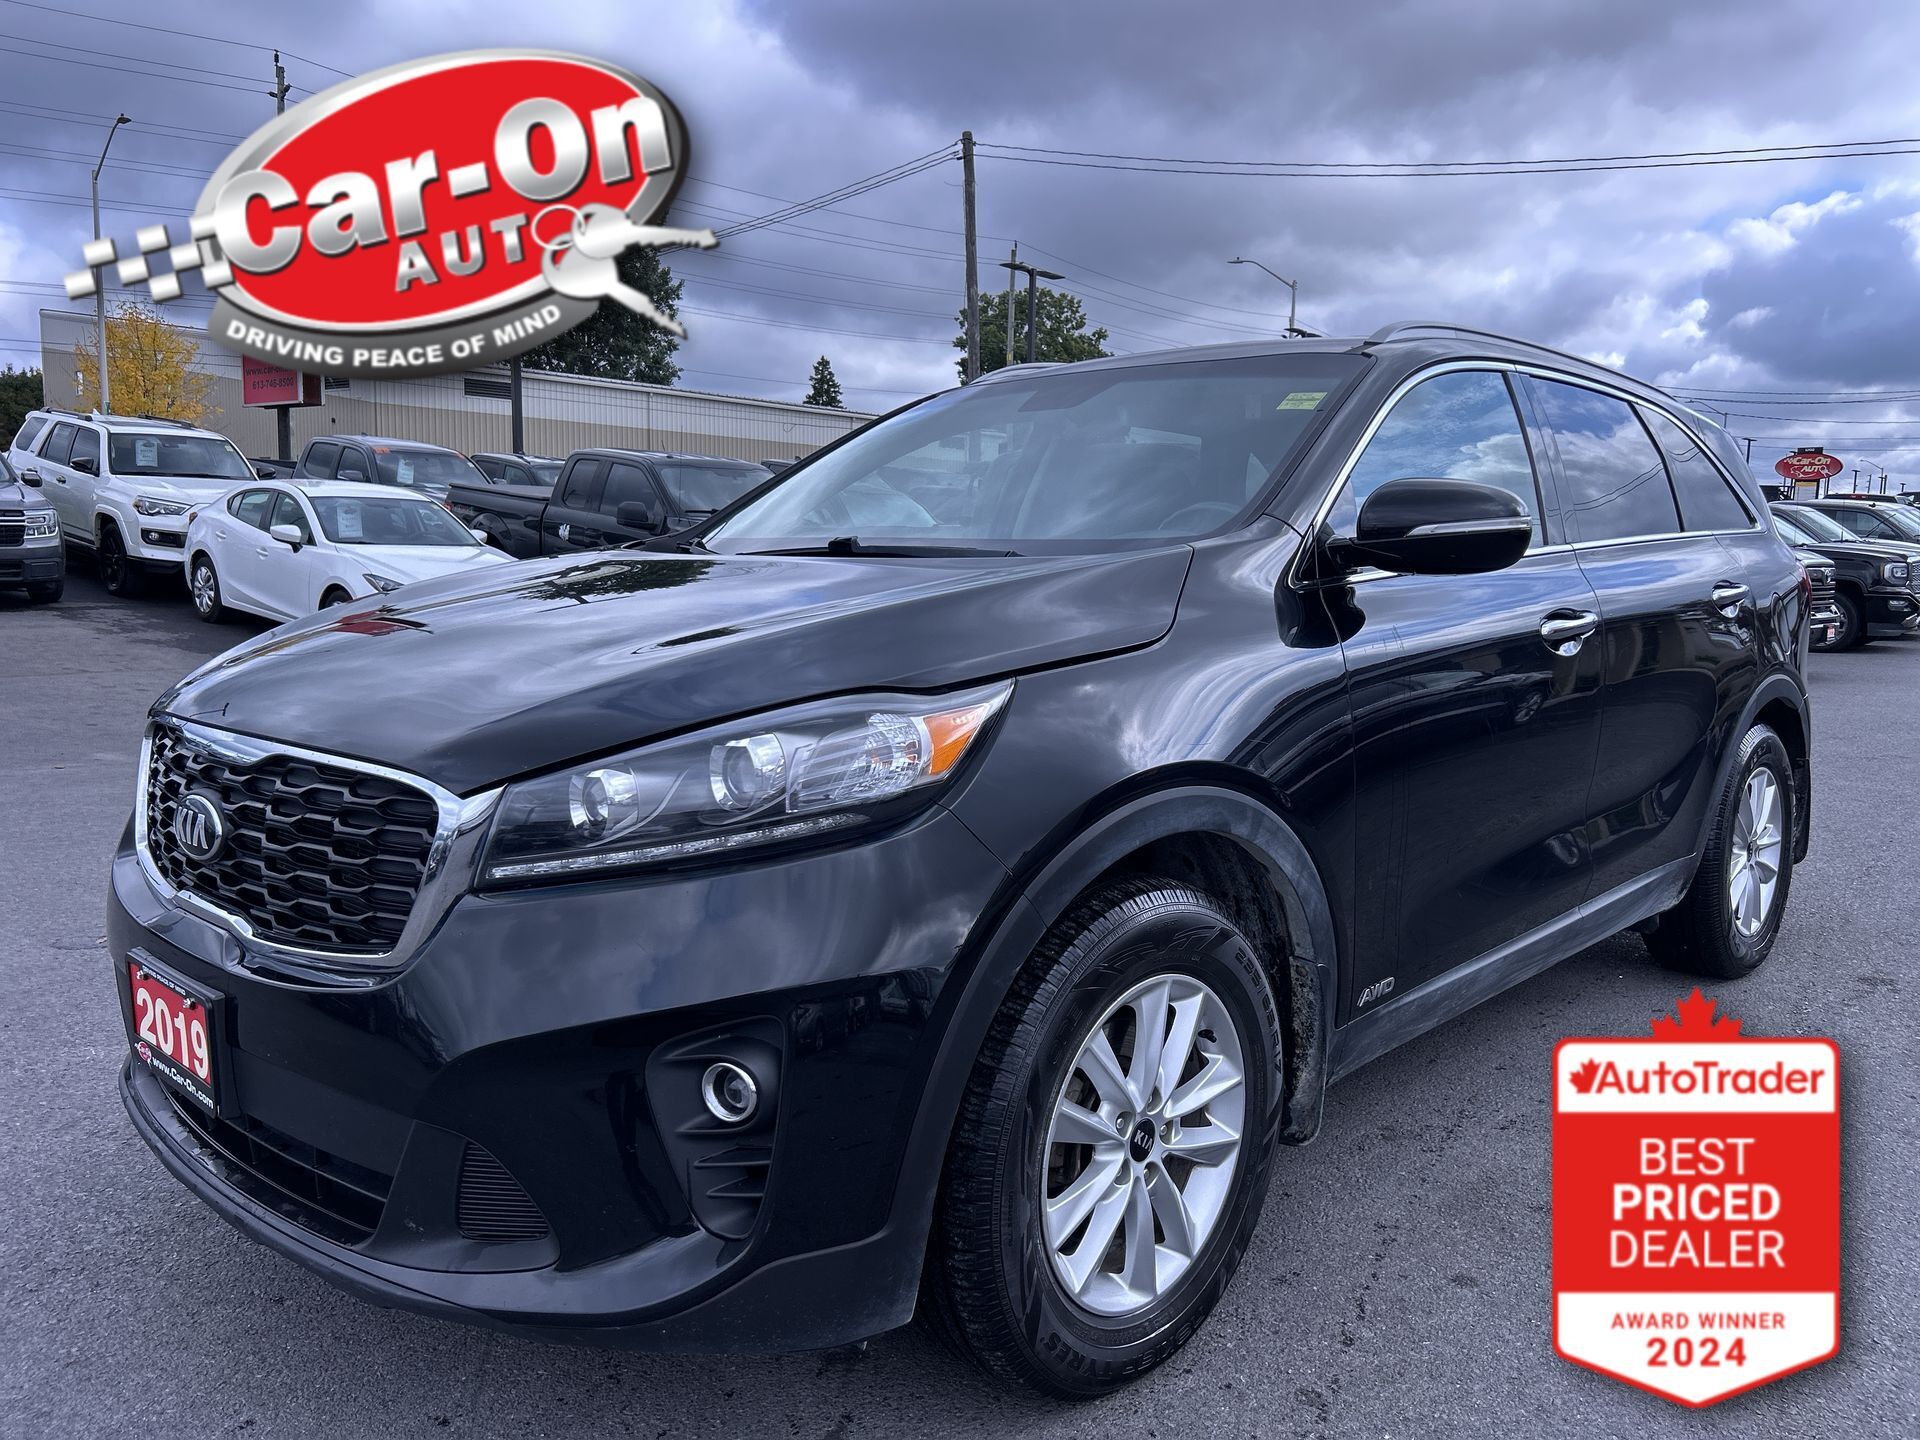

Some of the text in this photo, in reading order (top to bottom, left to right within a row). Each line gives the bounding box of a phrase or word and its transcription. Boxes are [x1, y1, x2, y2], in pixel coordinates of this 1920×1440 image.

[1795, 456, 1831, 465] Car-On
[176, 806, 208, 850] KIA
[1357, 977, 1395, 1007] AWD
[136, 987, 209, 1079] 2019
[152, 1056, 214, 1110] www.Car-On.com
[1133, 1129, 1153, 1152] KIA
